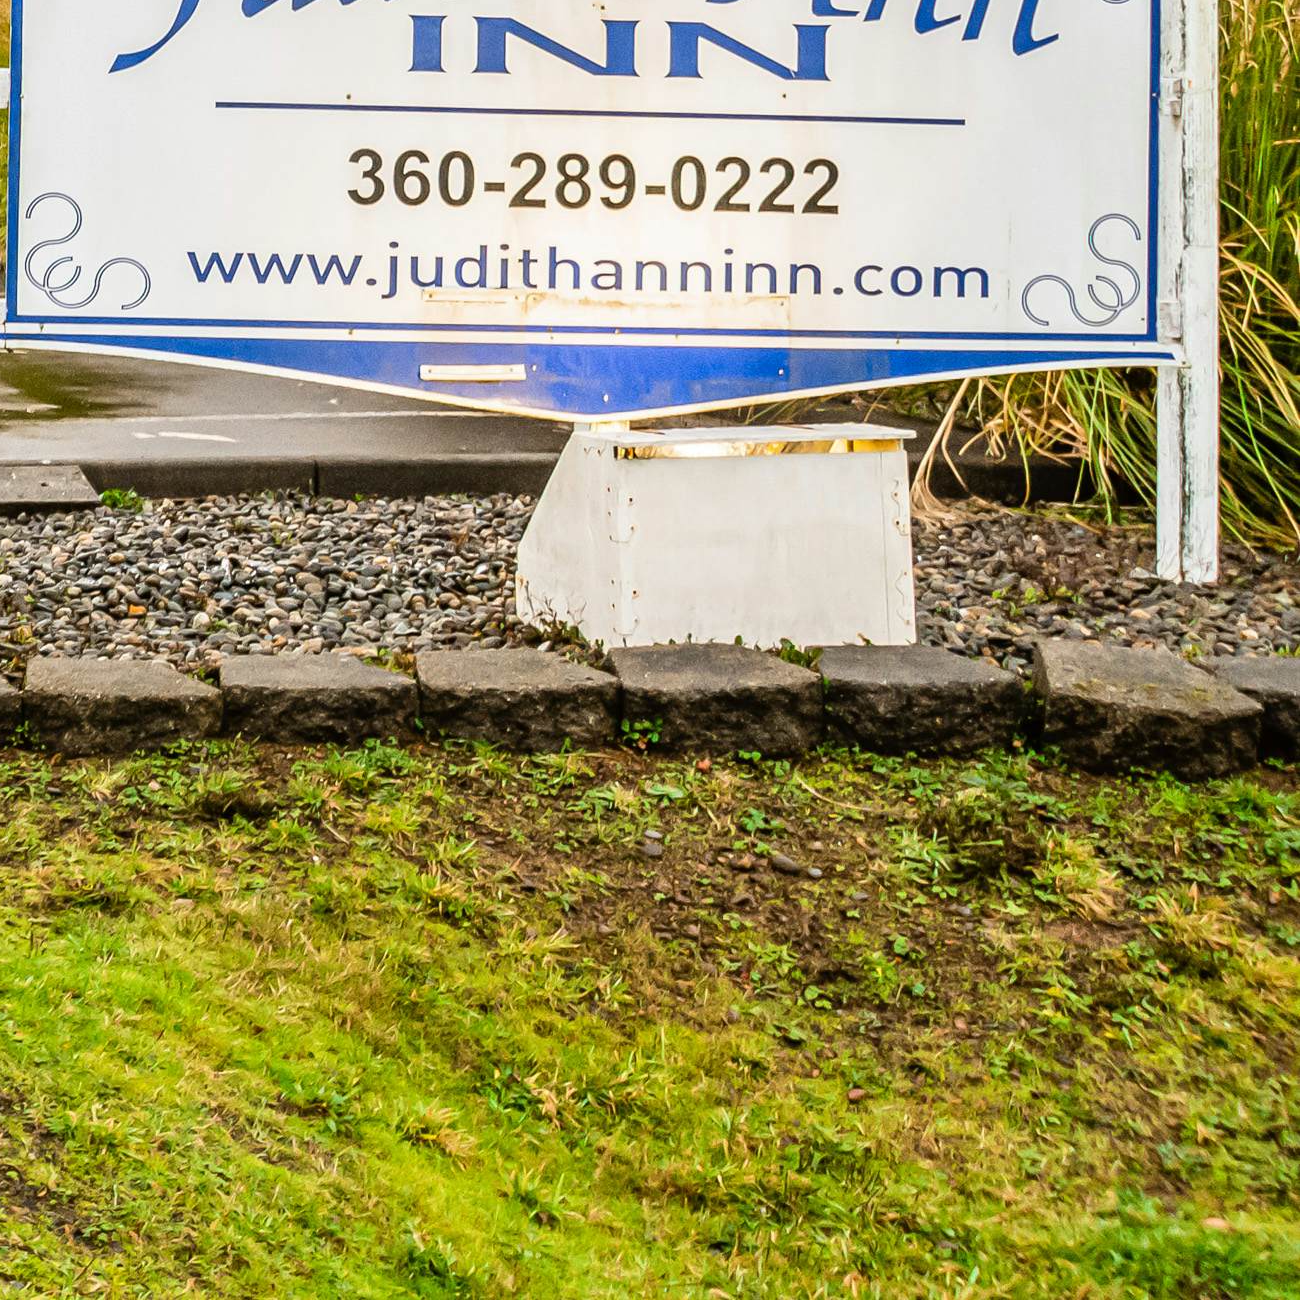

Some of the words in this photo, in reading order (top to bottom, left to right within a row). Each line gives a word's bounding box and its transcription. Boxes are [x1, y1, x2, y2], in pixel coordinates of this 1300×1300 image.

[407, 14, 832, 82] INN
[347, 148, 839, 215] 360-289-0222
[186, 241, 989, 300] www.judithanninn.com
